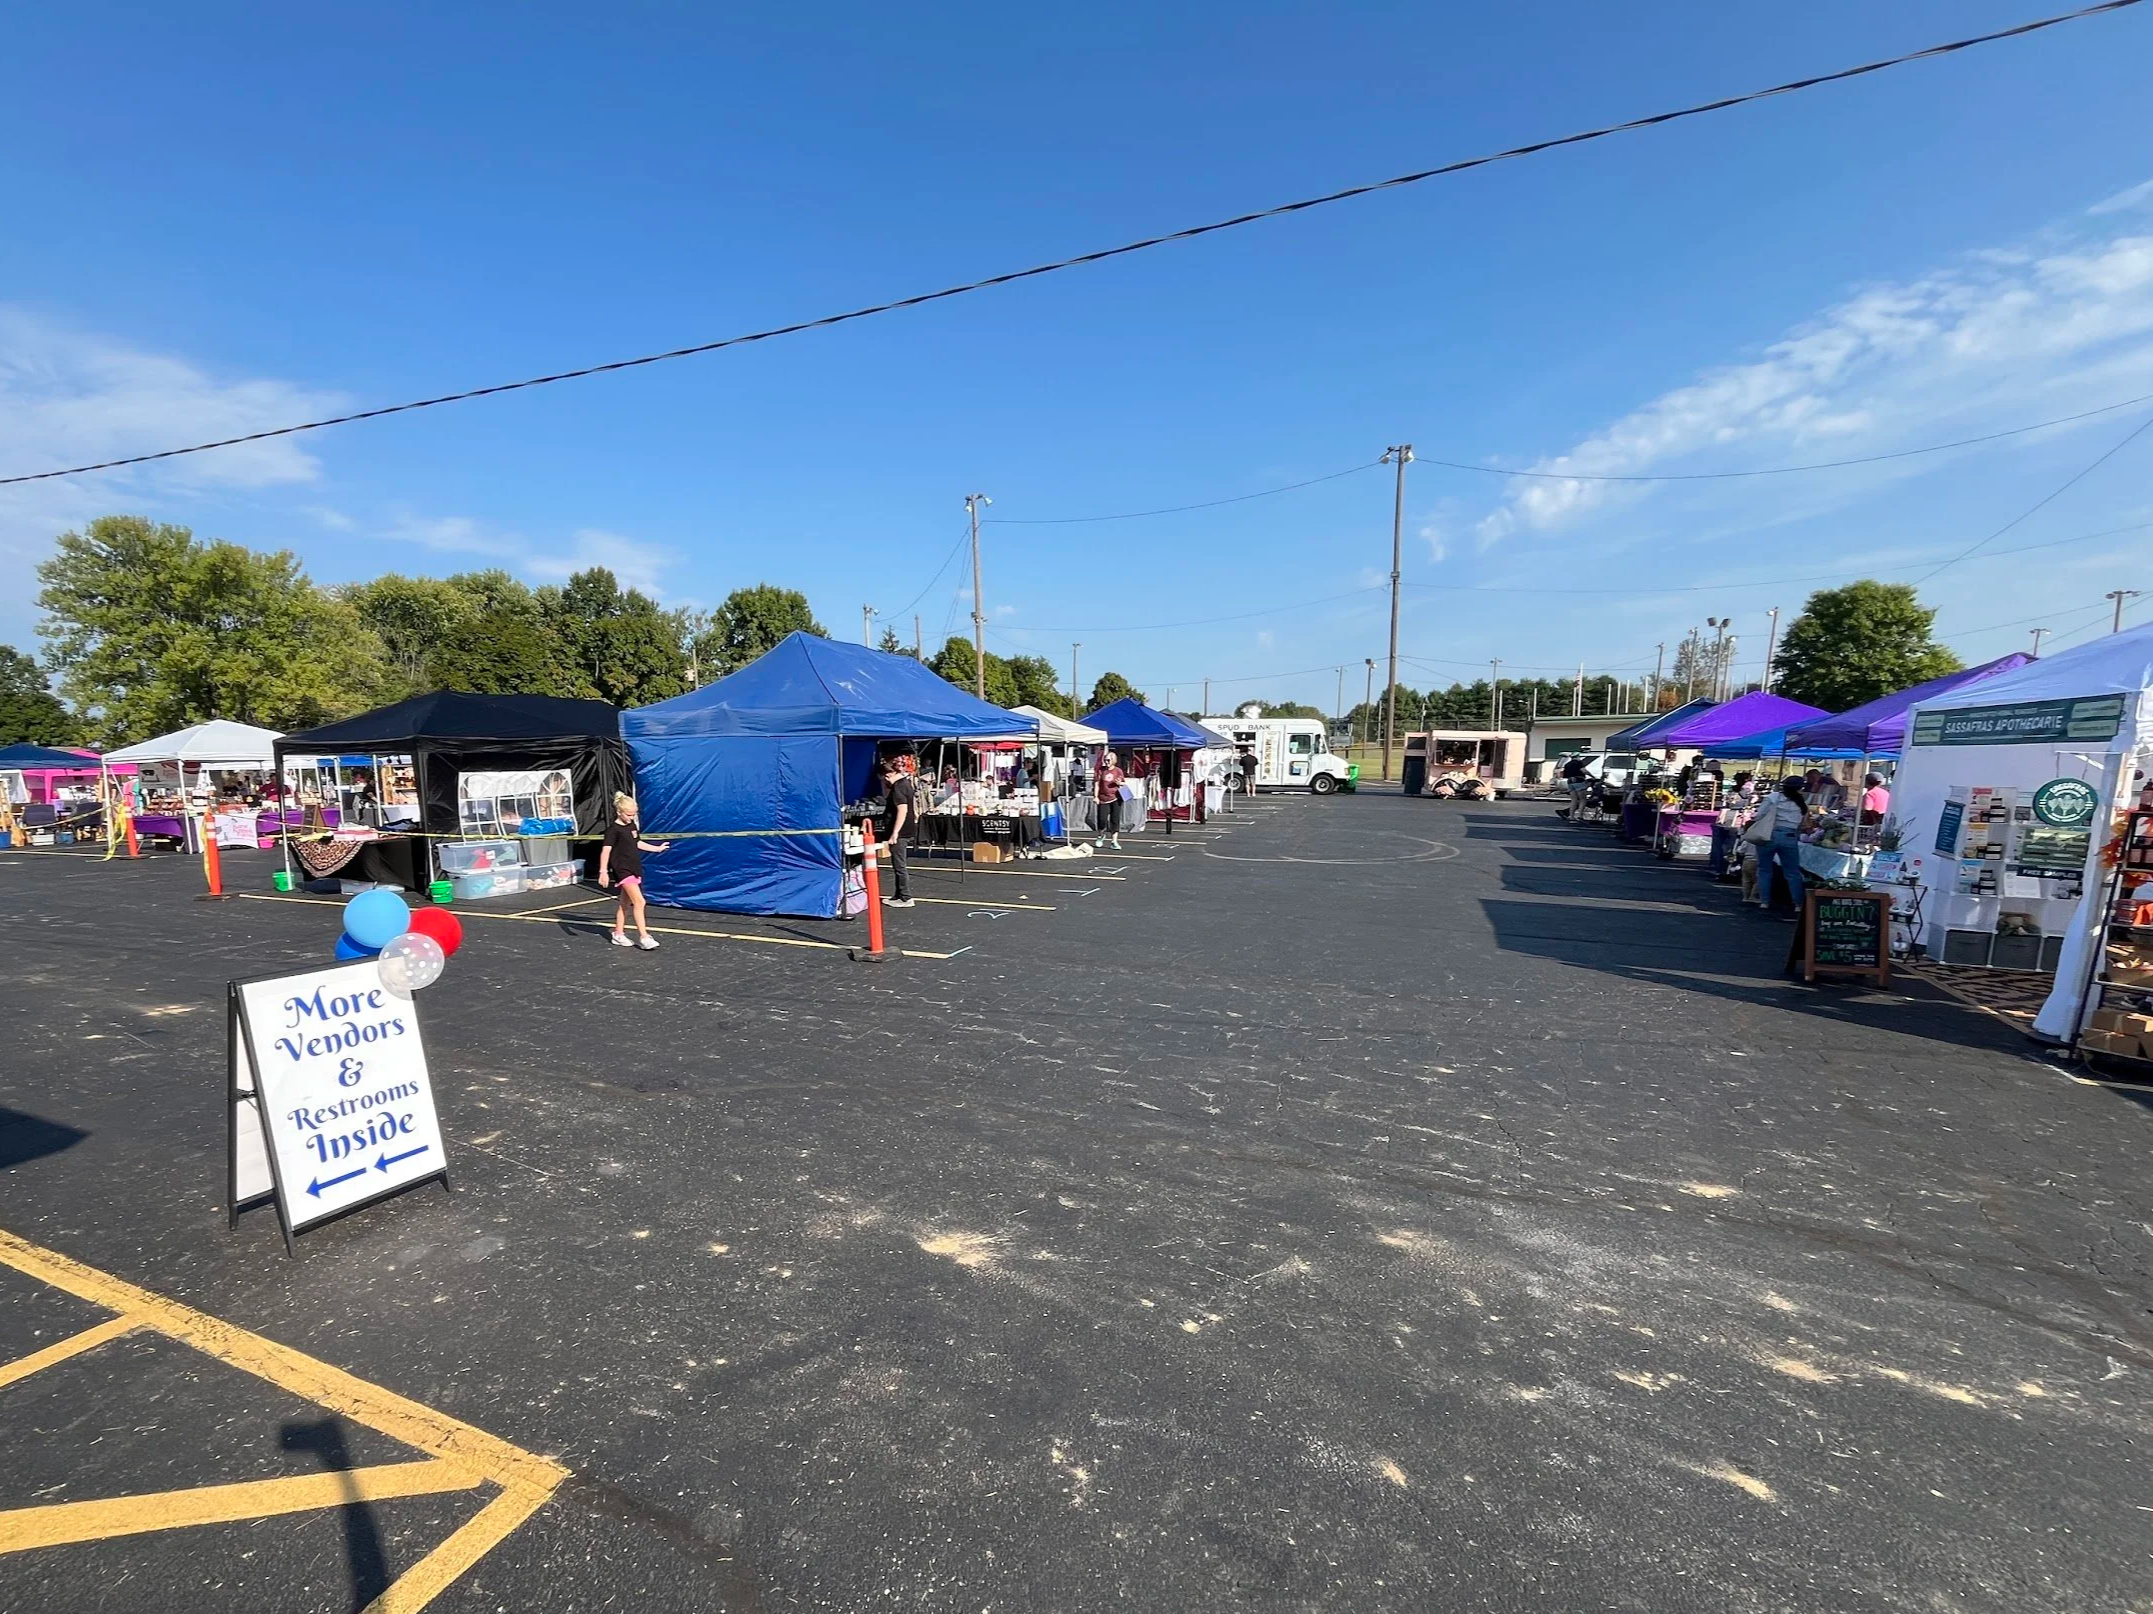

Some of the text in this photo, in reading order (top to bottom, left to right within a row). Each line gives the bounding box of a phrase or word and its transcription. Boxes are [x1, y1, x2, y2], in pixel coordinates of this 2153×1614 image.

[1945, 719, 1993, 734] SASSAFRAS
[1995, 715, 2063, 731] APOTHECARIE
[981, 819, 1011, 827] SCENTSY
[283, 984, 387, 1029] More
[274, 1014, 405, 1062] Vendors
[337, 1057, 364, 1087] &
[287, 1080, 419, 1131] Restrooms
[306, 1110, 418, 1164] Inside
